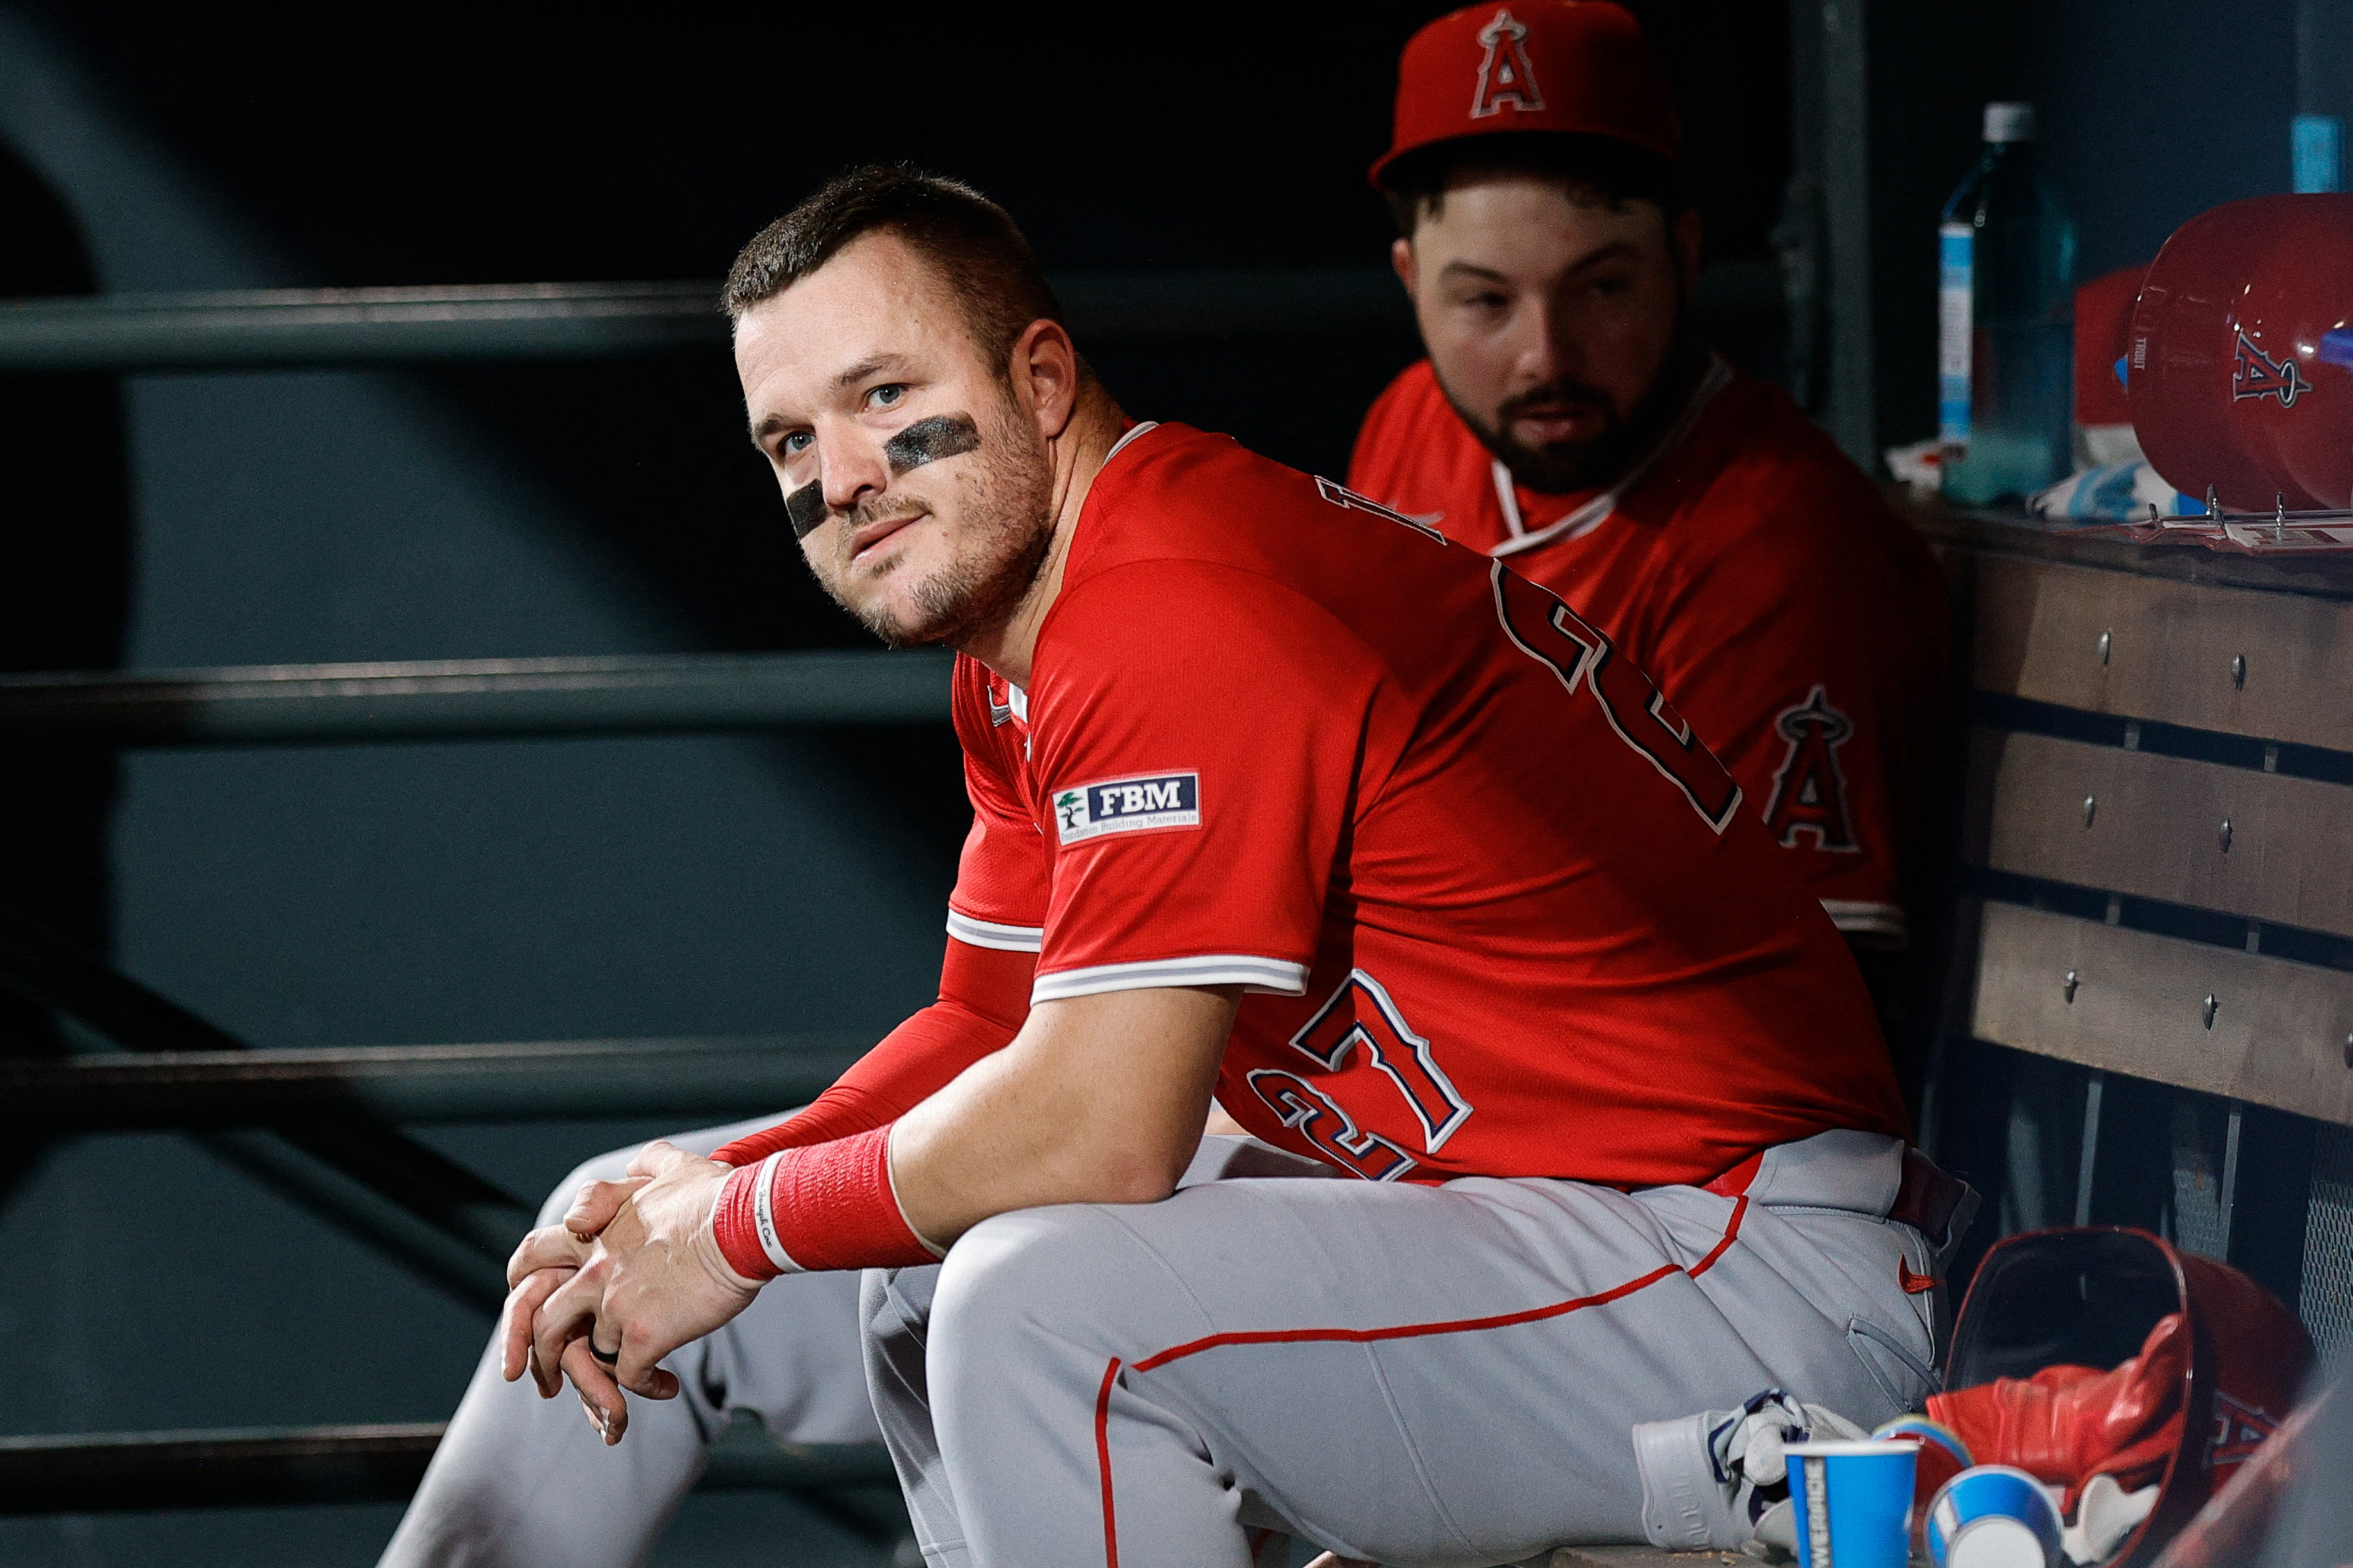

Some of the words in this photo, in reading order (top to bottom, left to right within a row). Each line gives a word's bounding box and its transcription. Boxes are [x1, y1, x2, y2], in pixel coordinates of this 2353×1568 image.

[1469, 8, 1545, 120] A
[2133, 337, 2147, 370] TROUT
[2232, 329, 2314, 408] A
[1099, 780, 1181, 817] FBM
[1761, 683, 1862, 853] A
[1100, 818, 1144, 832] Building
[1146, 812, 1197, 828] Materials
[1246, 968, 1474, 1182] 27
